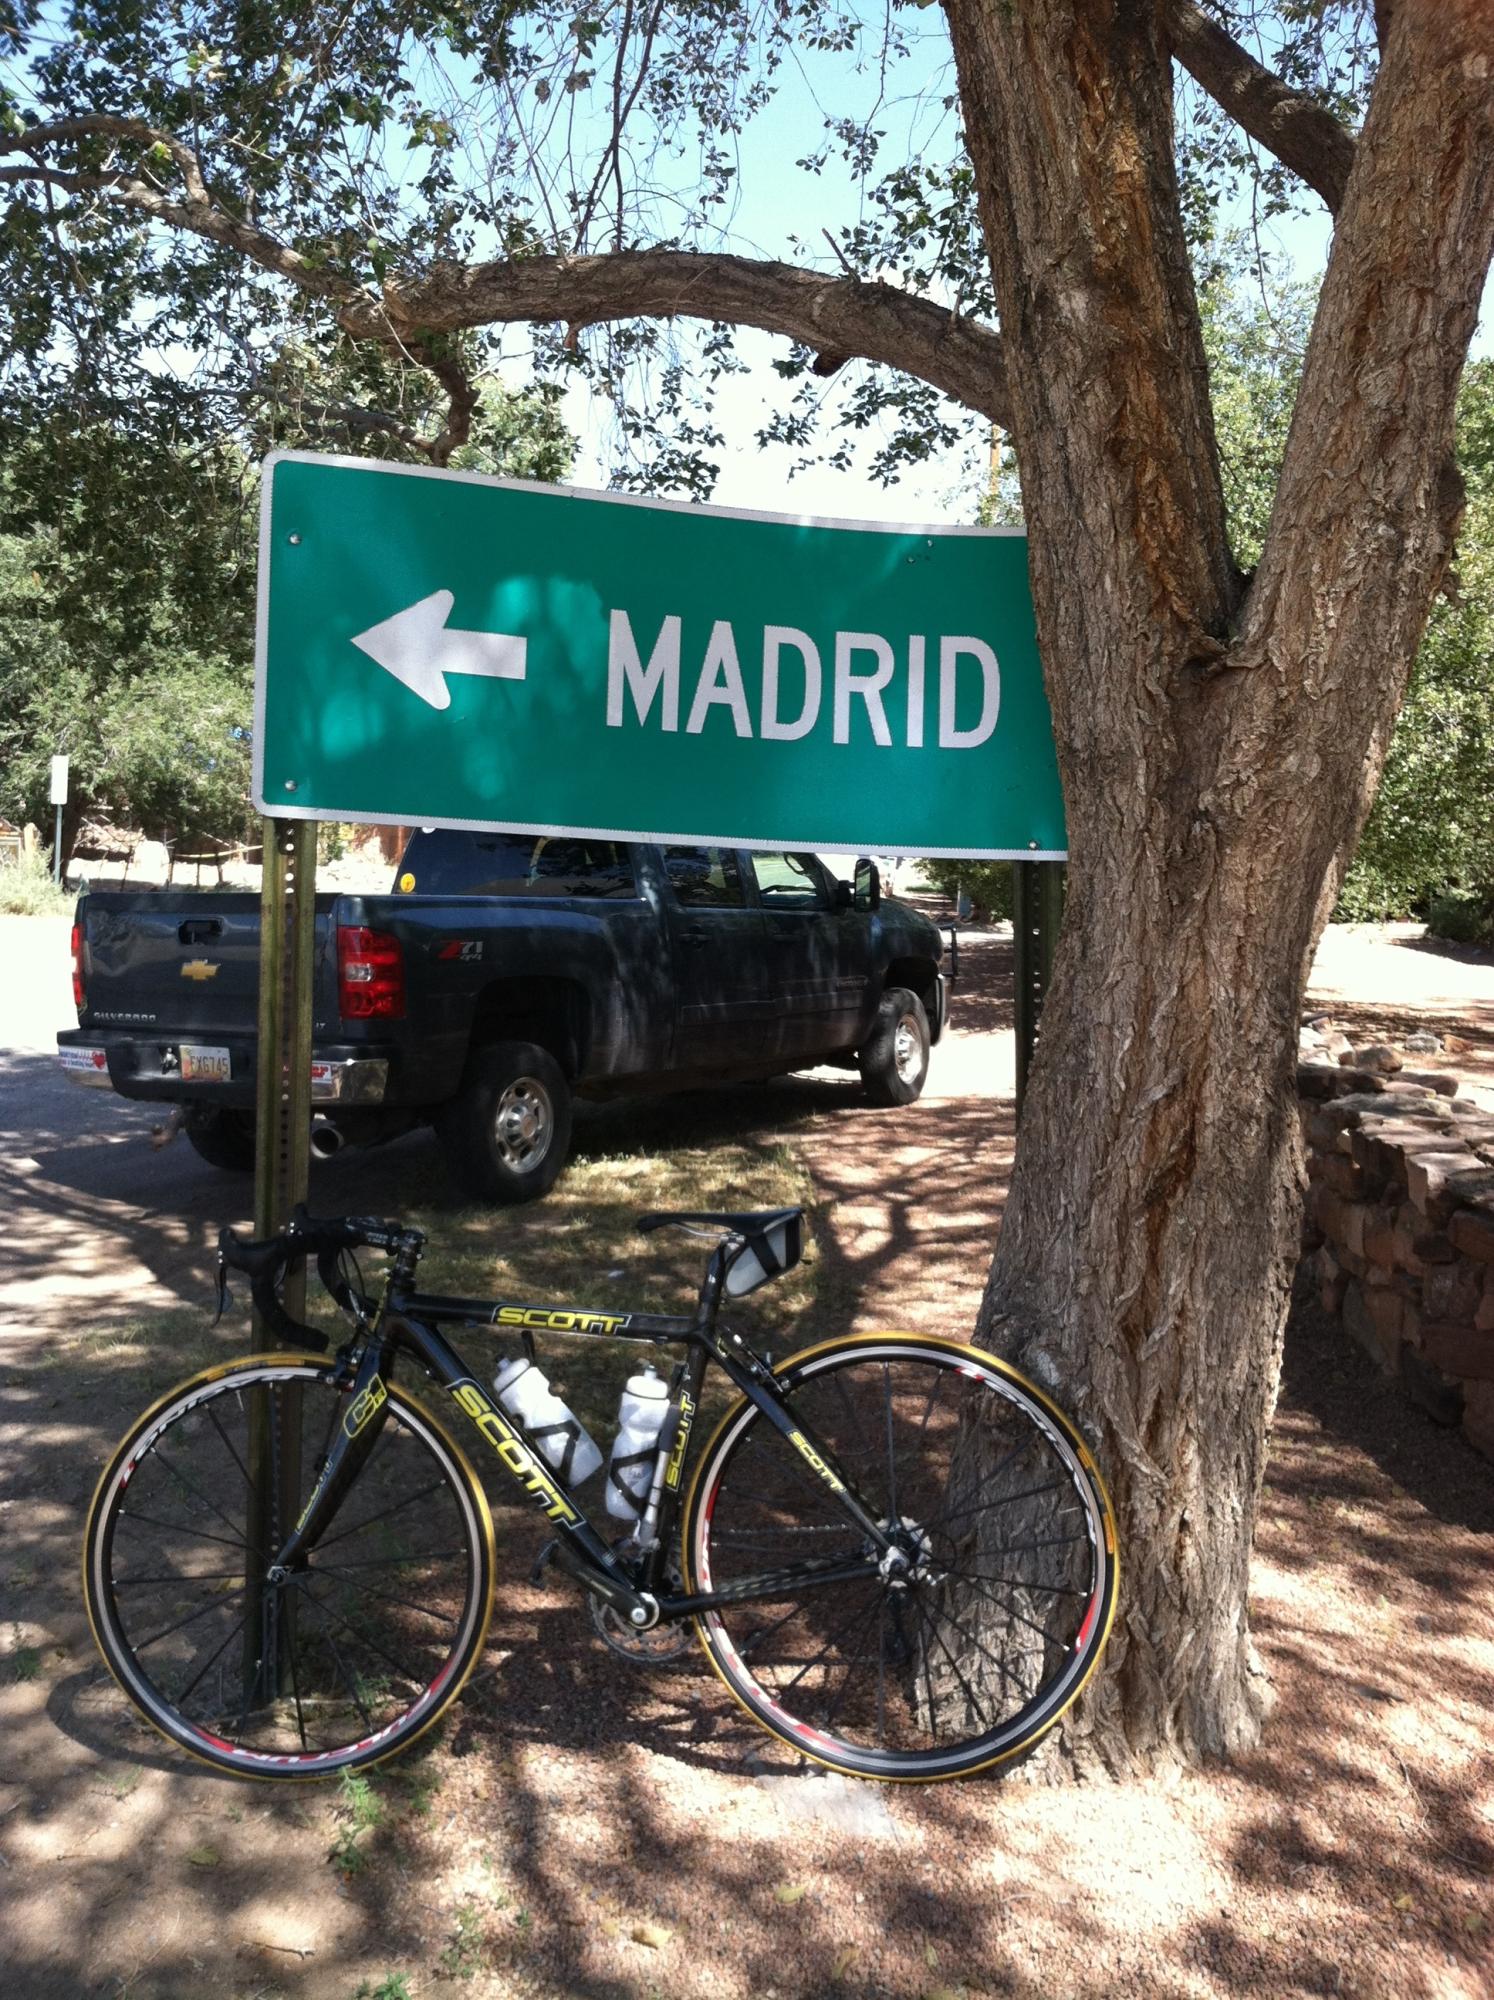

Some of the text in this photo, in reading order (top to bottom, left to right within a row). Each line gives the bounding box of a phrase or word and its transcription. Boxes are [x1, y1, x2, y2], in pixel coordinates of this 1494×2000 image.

[606, 608, 1001, 749] MADRID
[496, 1306, 625, 1333] SCOTT
[452, 1384, 578, 1522] SCOTT
[789, 1431, 845, 1491] SCOTT
